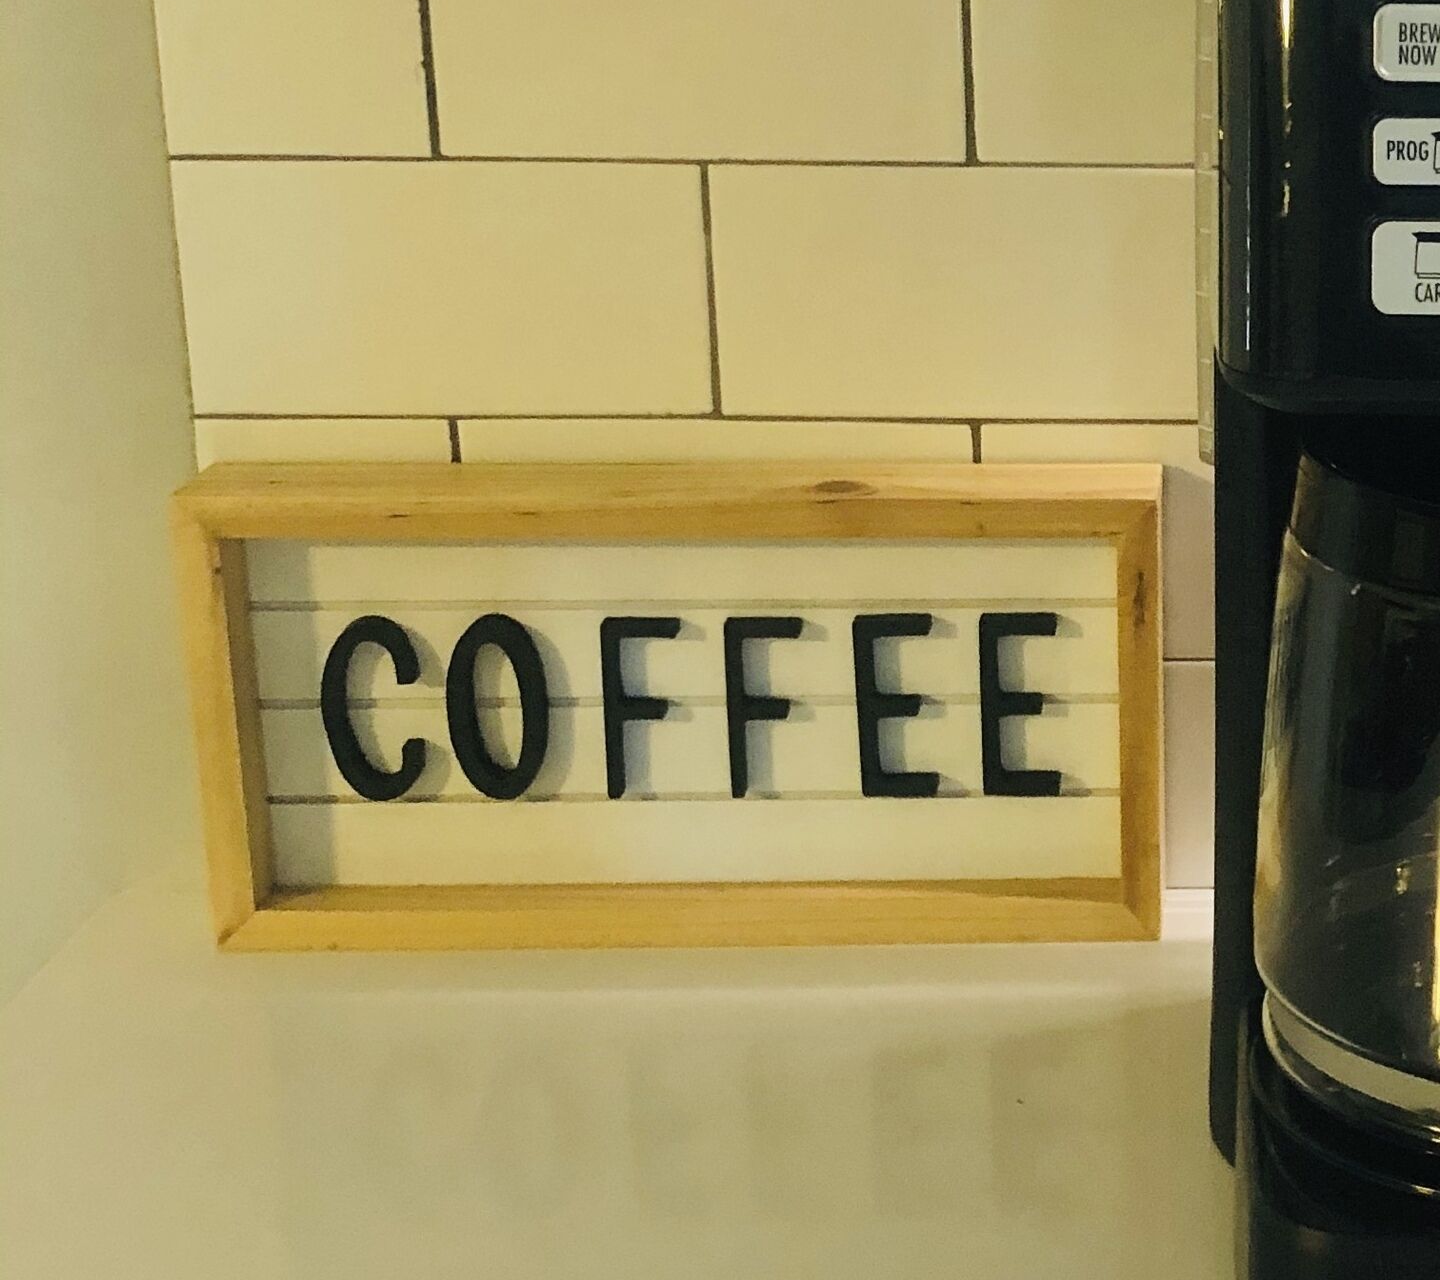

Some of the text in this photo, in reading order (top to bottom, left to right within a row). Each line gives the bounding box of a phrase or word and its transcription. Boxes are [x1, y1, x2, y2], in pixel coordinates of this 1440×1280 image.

[1398, 44, 1437, 66] NOW
[1386, 139, 1429, 162] PROG
[320, 612, 1062, 802] COFFEE
